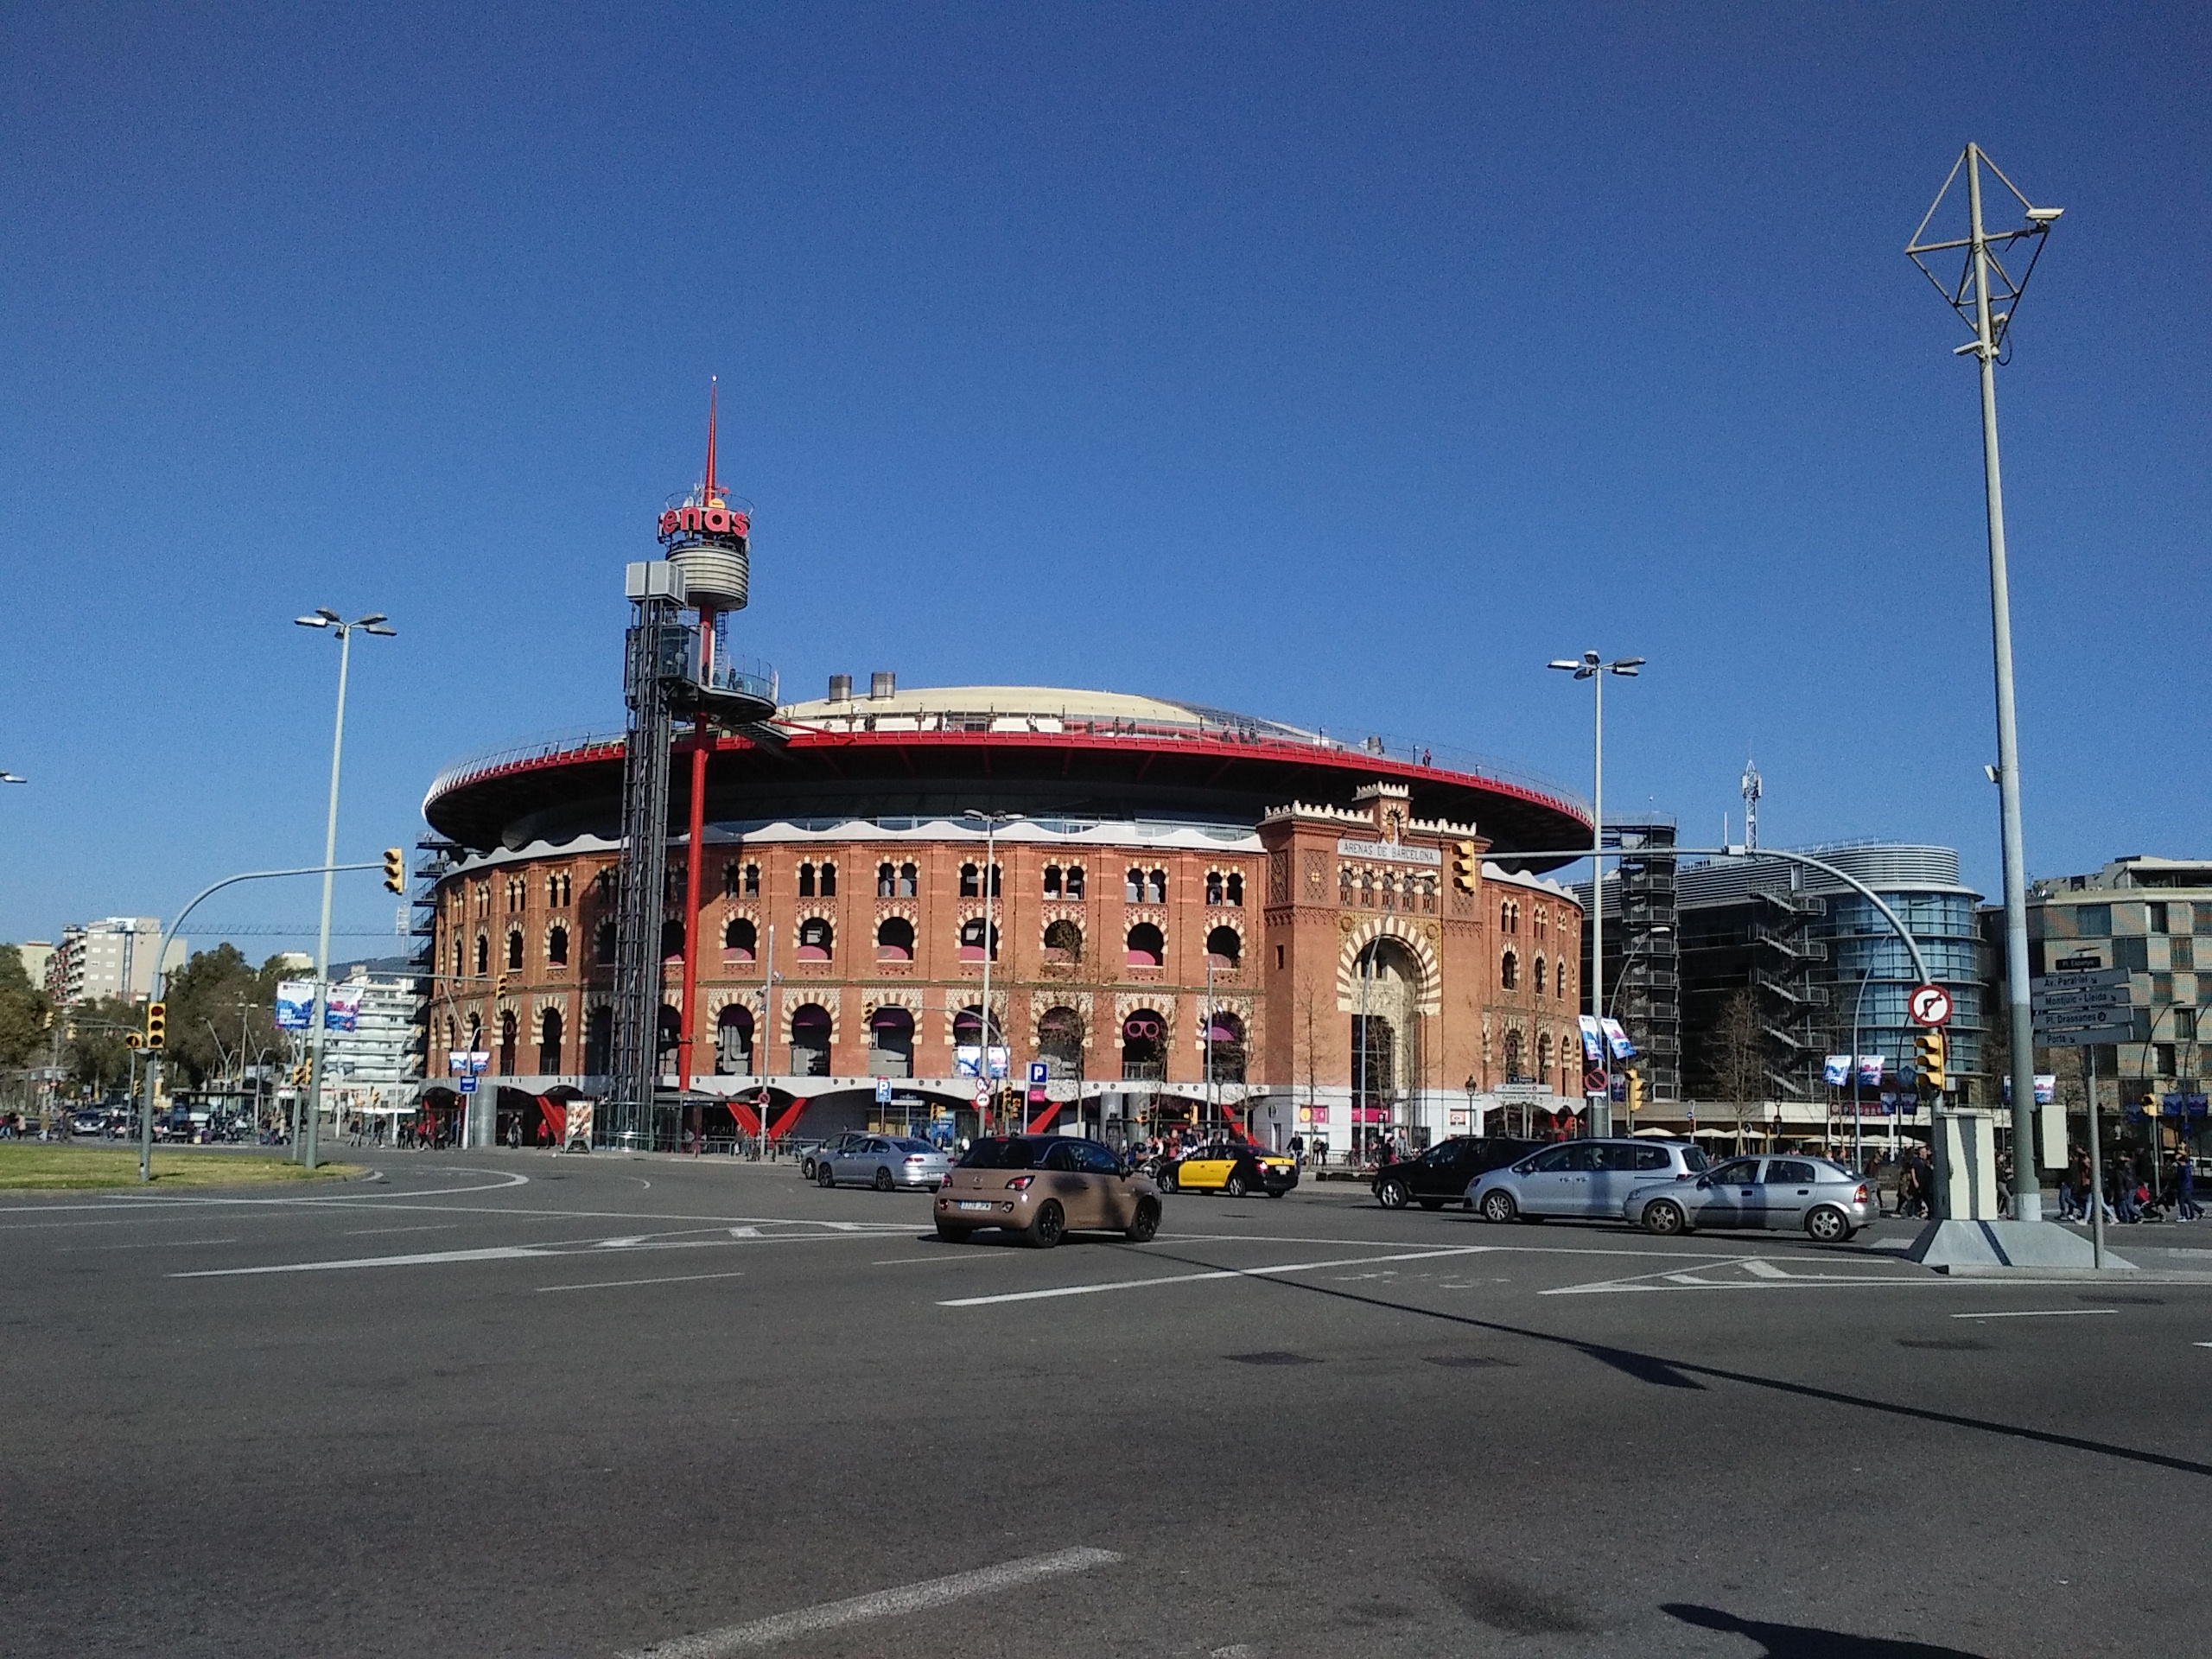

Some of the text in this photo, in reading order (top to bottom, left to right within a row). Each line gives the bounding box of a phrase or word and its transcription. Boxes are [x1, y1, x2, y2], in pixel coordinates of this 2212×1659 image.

[1344, 842, 1434, 861] ARENAS DE BARCELONA
[2057, 1014, 2096, 1024] Drassanes
[2047, 1034, 2066, 1044] Ports
[1034, 1066, 1044, 1080] P
[879, 1082, 888, 1093] P
